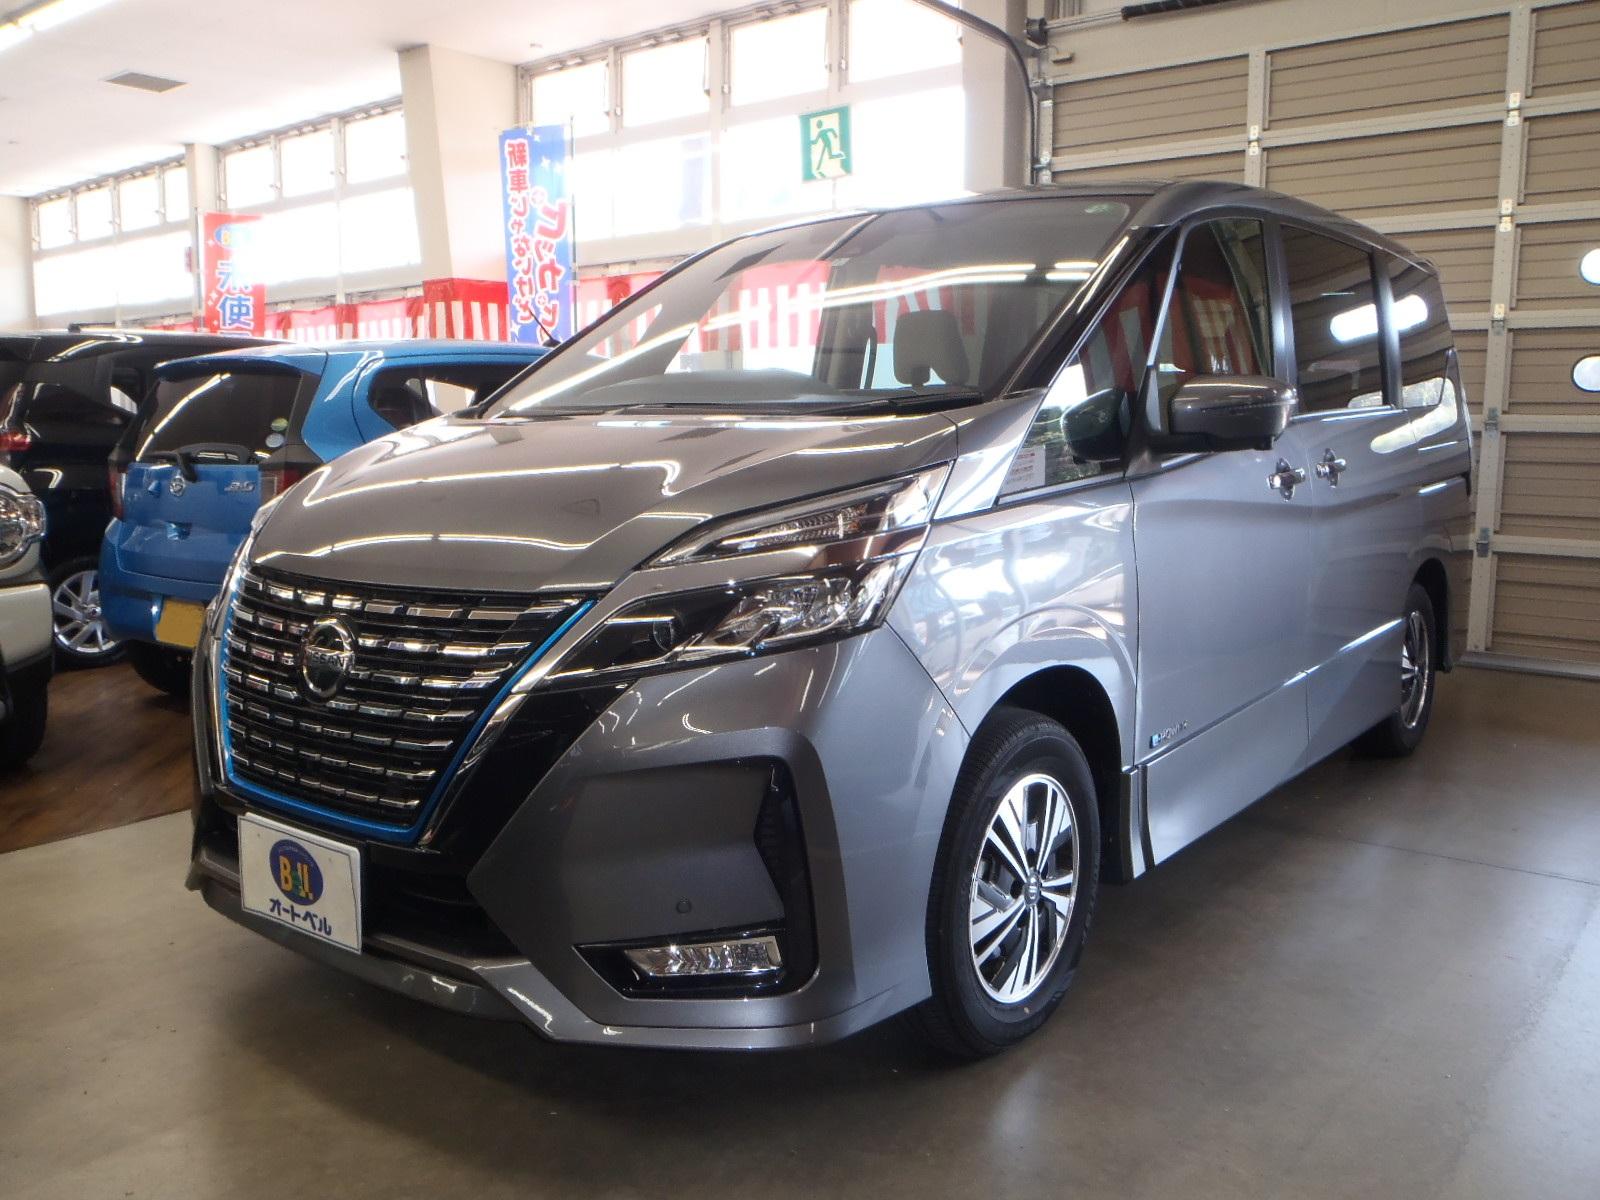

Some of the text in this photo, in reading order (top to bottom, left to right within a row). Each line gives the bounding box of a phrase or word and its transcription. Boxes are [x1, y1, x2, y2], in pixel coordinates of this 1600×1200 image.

[218, 261, 252, 337] 未使
[269, 898, 332, 936] オートベル
